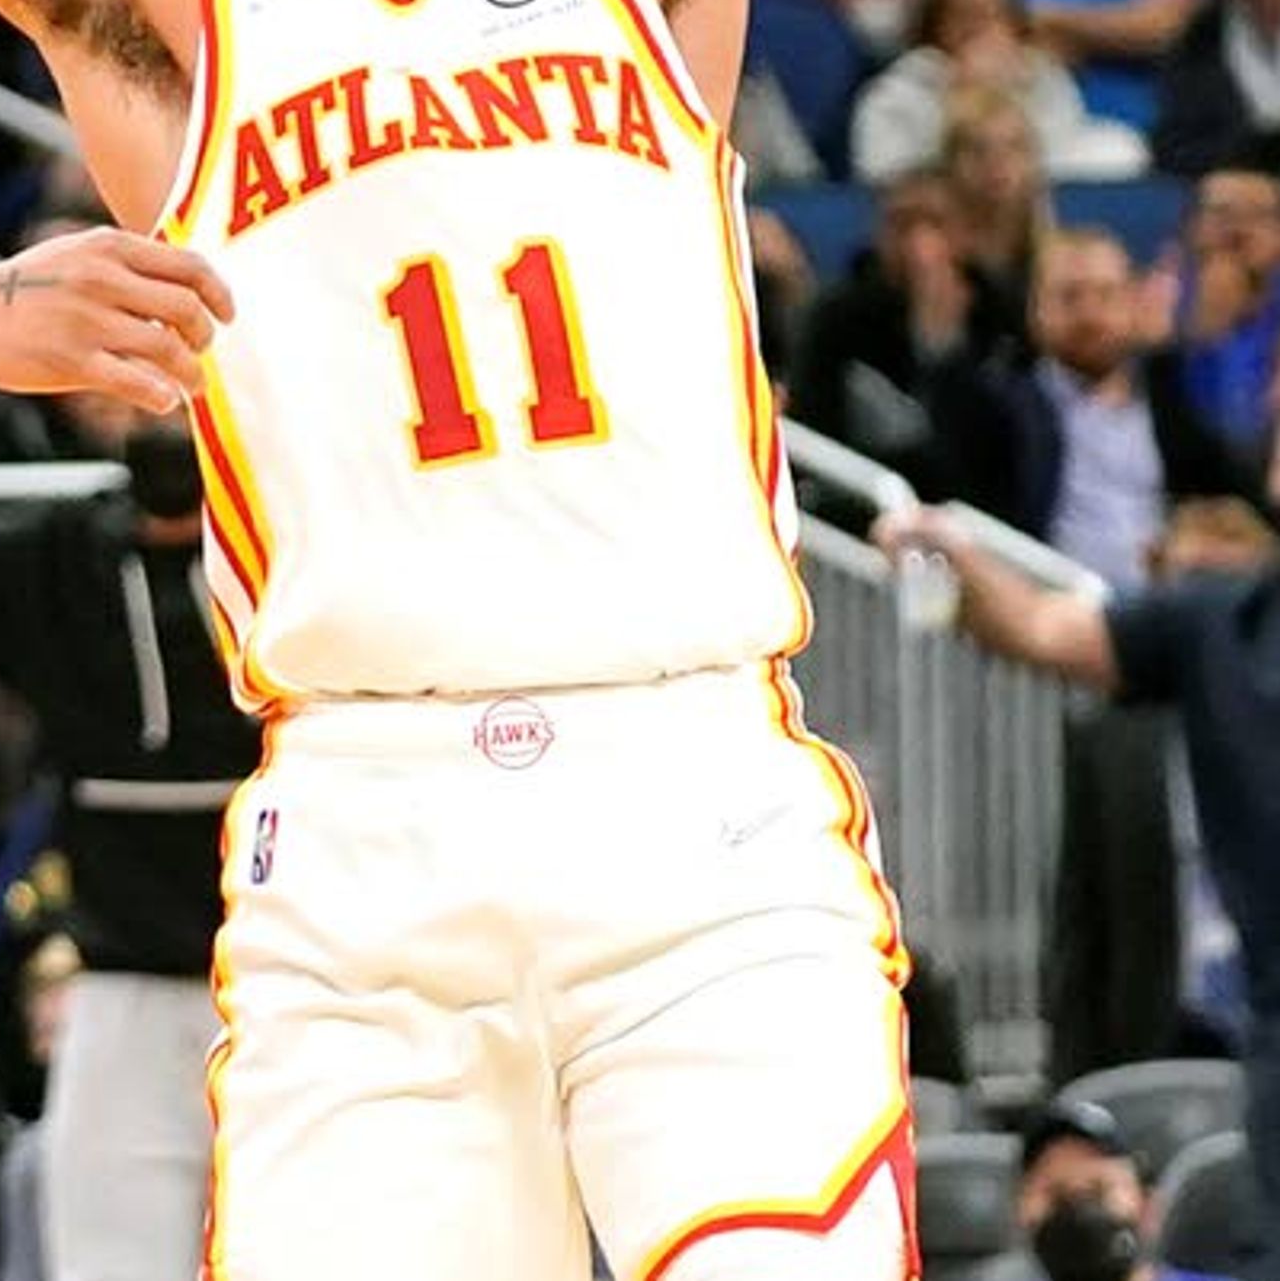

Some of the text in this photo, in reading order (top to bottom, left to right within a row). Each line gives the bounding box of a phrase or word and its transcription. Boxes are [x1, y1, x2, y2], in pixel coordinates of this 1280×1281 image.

[226, 51, 671, 239] ATLANTA
[380, 236, 611, 470] 11
[472, 720, 556, 747] HAWKS
